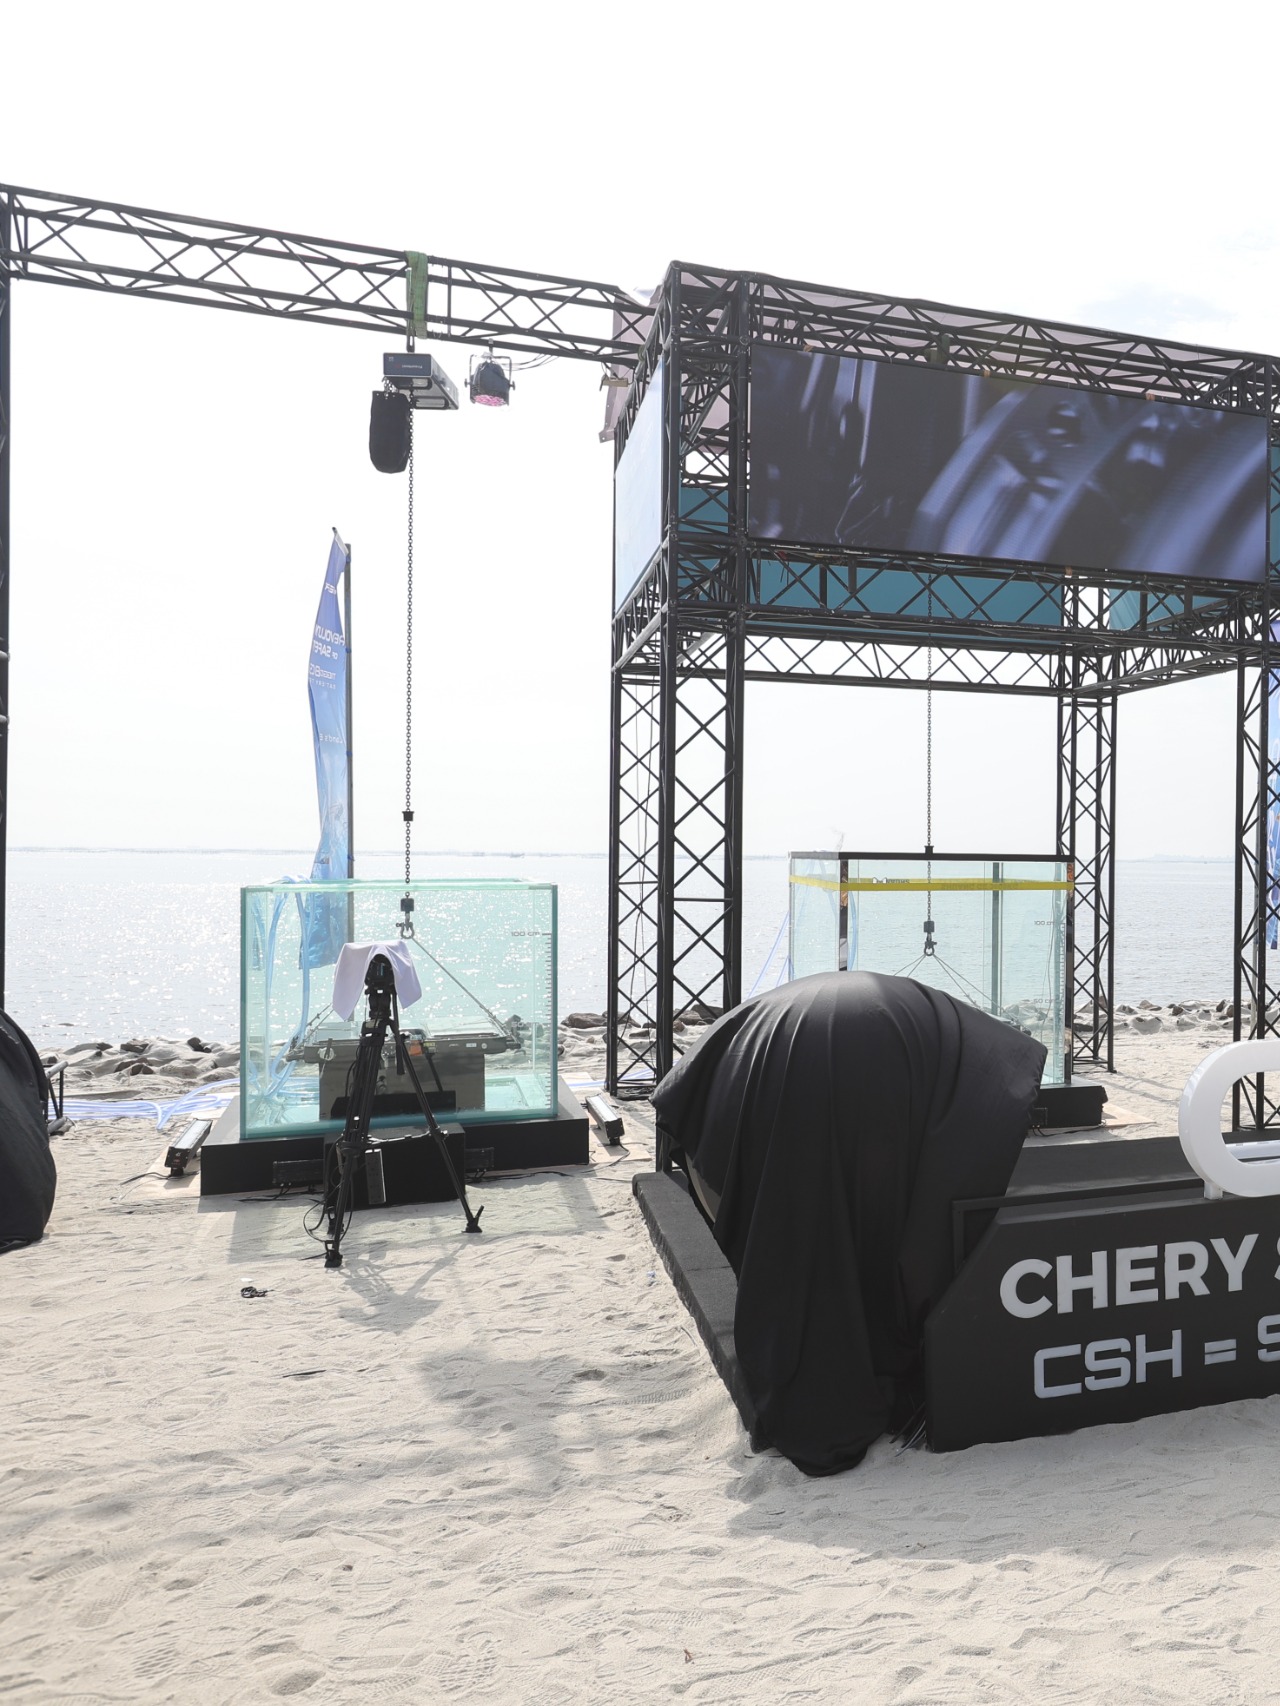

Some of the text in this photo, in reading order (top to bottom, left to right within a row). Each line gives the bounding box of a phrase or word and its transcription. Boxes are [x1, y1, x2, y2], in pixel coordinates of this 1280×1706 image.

[1000, 1234, 1259, 1319] CHERY
[1034, 1329, 1183, 1399] CSH
[1204, 1338, 1237, 1365] =
